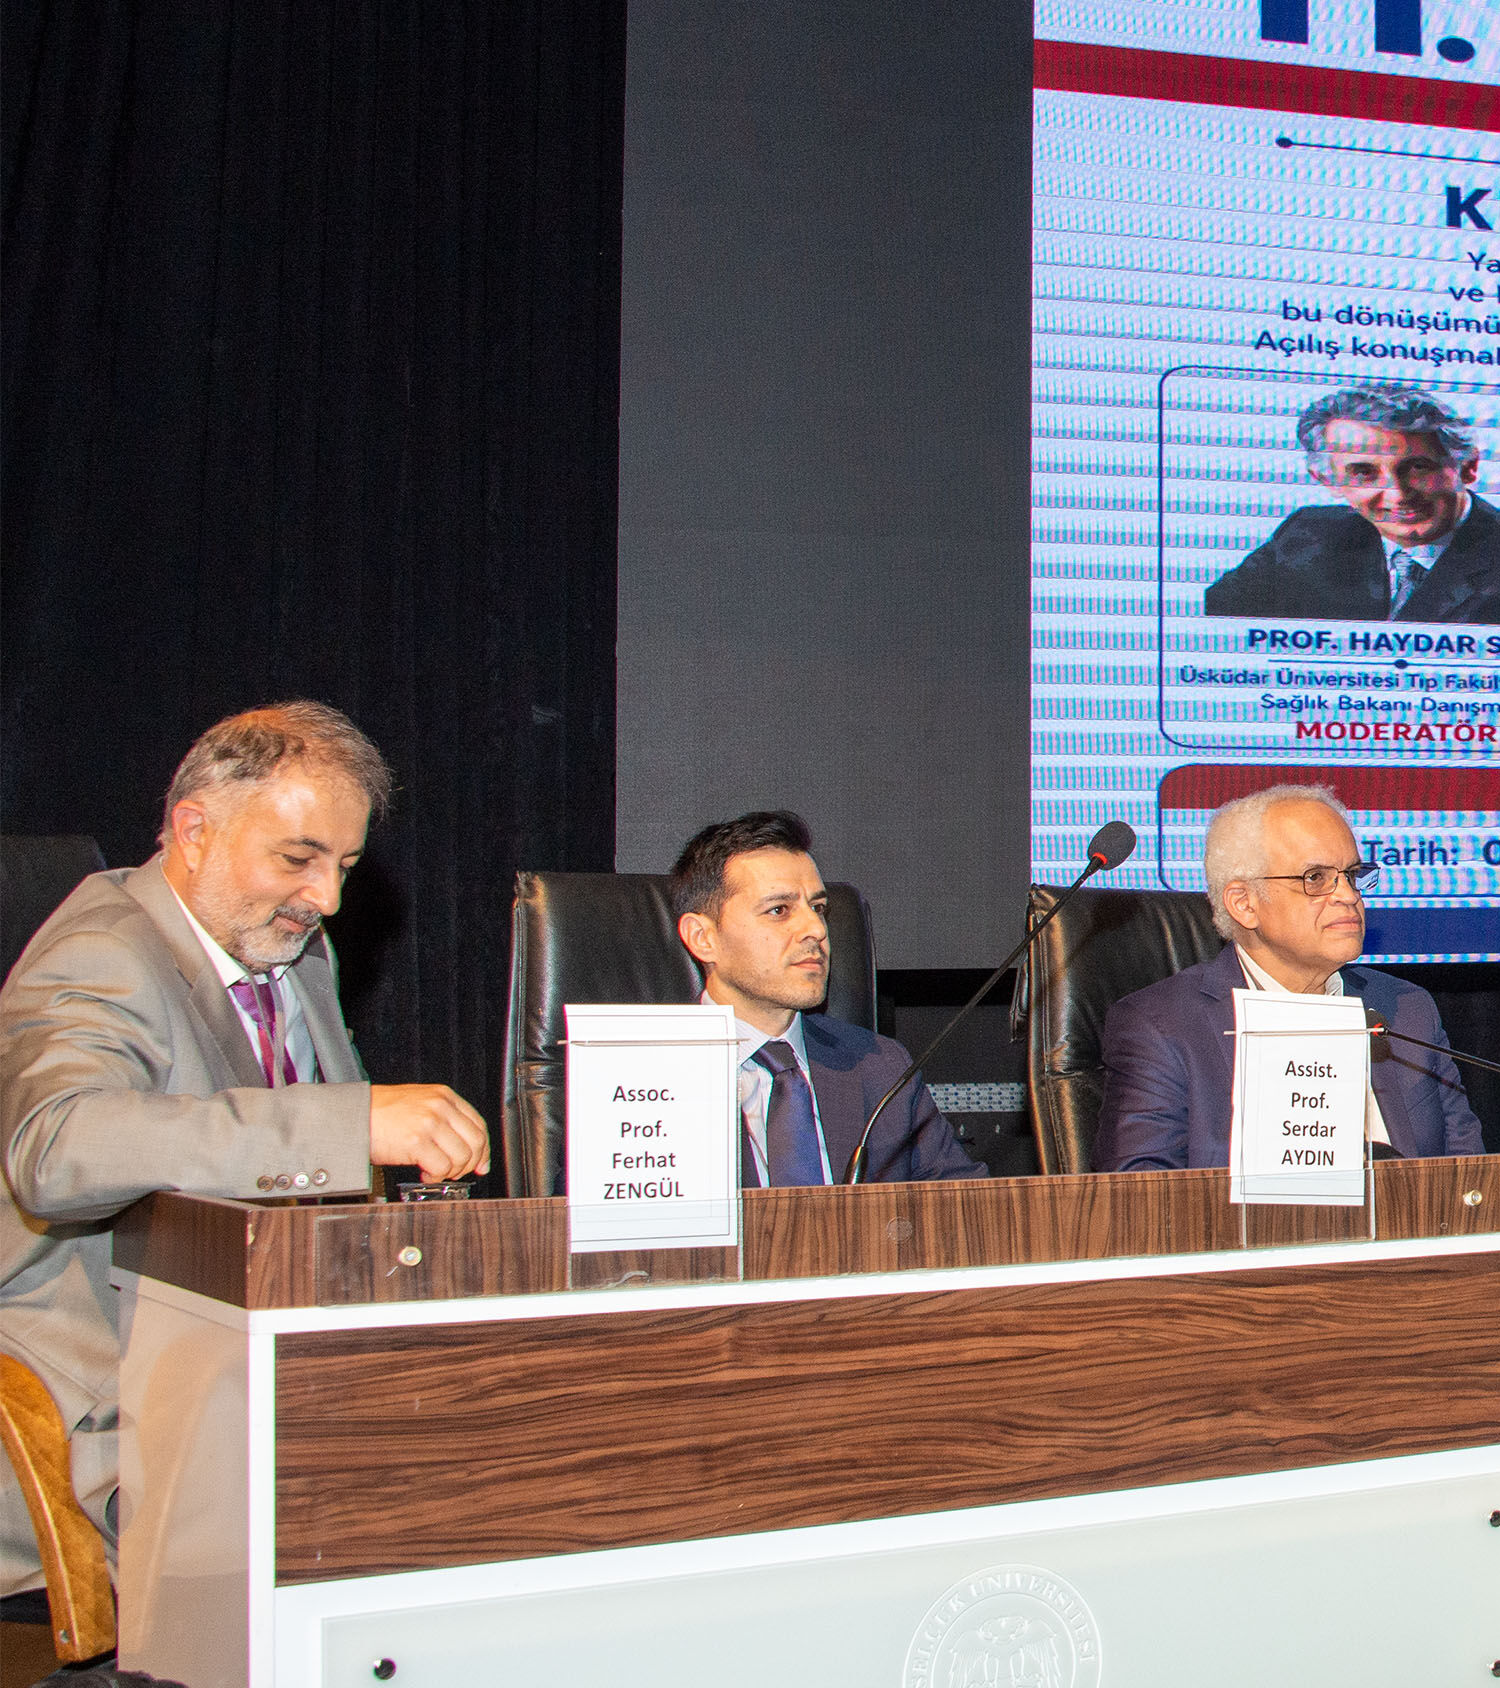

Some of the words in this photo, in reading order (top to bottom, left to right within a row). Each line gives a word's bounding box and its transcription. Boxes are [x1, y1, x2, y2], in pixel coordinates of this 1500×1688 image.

[1449, 287, 1485, 303] ve
[1282, 300, 1322, 323] bu
[1254, 331, 1340, 361] Açılış
[1247, 628, 1338, 651] PROF.
[1349, 632, 1476, 655] HAYDAR
[1180, 667, 1269, 687] Üsküdar
[1277, 668, 1400, 688] Üniversitesi
[1408, 674, 1438, 693] Tıp
[1260, 694, 1326, 713] Sağlık
[1338, 696, 1412, 713] Bakanı
[1295, 719, 1498, 743] MODERATÖR
[1361, 840, 1459, 867] Tarih:
[1284, 1060, 1338, 1079] Assist.
[612, 1085, 676, 1102] Assoc.
[1291, 1092, 1330, 1109] Prof.
[620, 1120, 668, 1138] Prof.
[1281, 1120, 1337, 1138] Serdar
[611, 1151, 677, 1170] Ferhat
[1280, 1149, 1335, 1166] AYDIN
[603, 1177, 685, 1200] ZENGÜL
